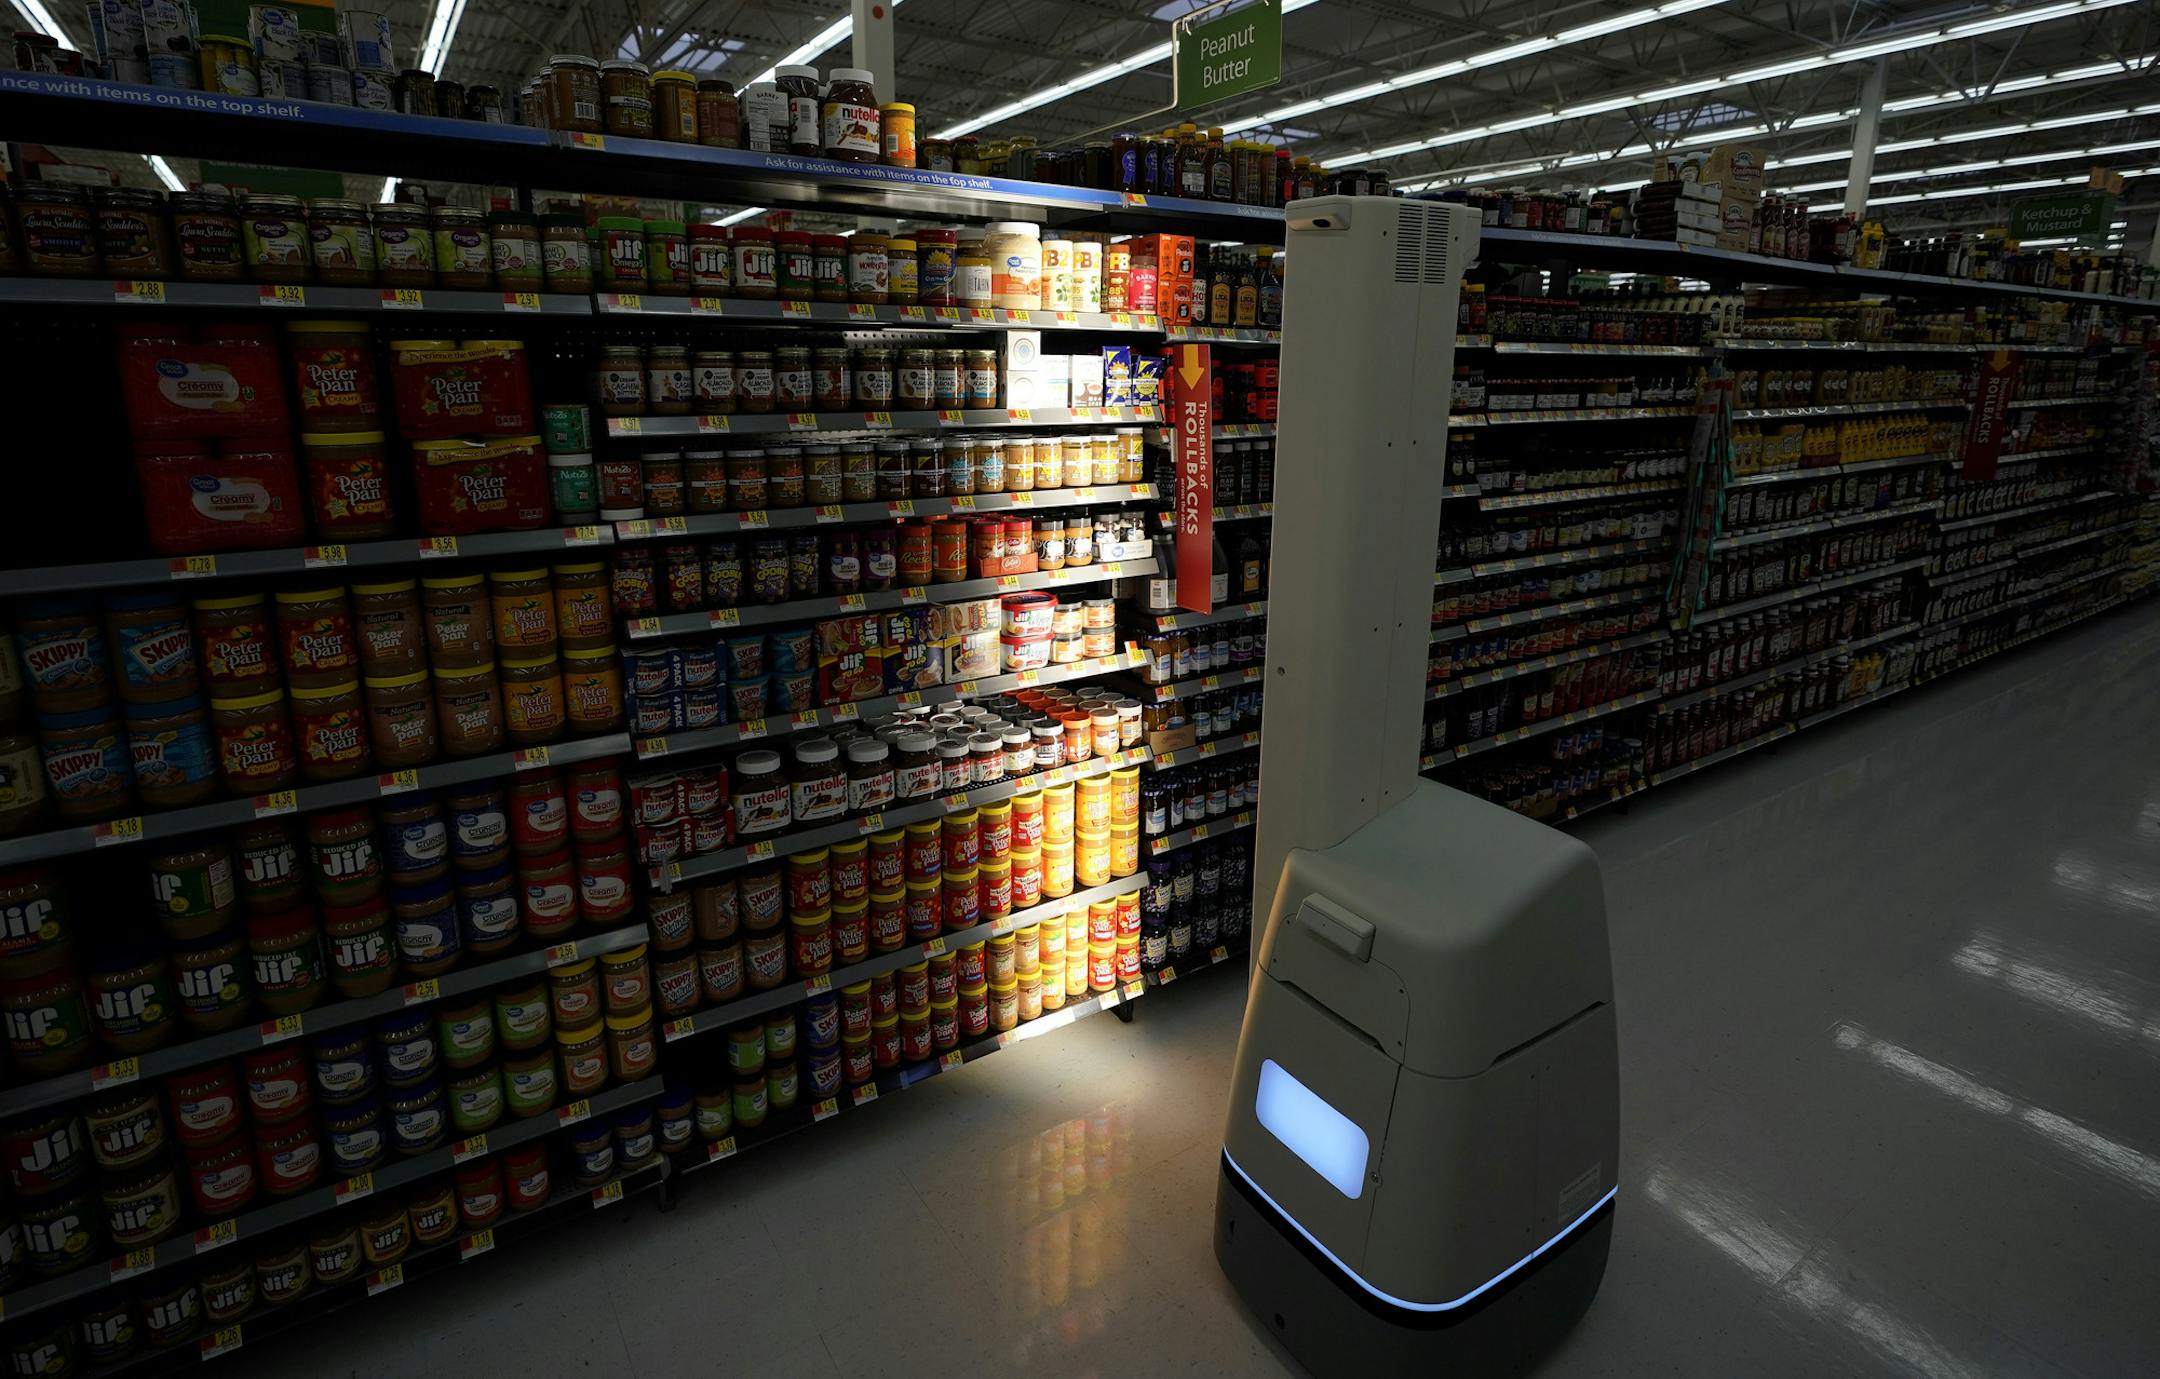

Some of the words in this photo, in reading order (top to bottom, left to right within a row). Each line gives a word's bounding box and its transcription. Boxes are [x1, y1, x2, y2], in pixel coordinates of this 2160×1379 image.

[1201, 23, 1255, 60] Peanut
[1203, 57, 1251, 89] Butter
[45, 77, 91, 97] with
[97, 83, 151, 103] items
[157, 91, 180, 106] on
[186, 91, 217, 109] the
[222, 97, 252, 116] top
[258, 101, 304, 119] shelf.
[842, 106, 881, 124] nutella
[765, 157, 786, 168] Ask
[788, 160, 804, 171] for
[807, 163, 861, 176] assistance
[863, 168, 886, 178] with
[887, 170, 915, 181] items
[917, 174, 930, 183] on
[932, 174, 948, 184] the
[950, 176, 966, 188] top
[968, 178, 993, 189] shelf.
[2022, 204, 2078, 222] Ketchup
[2081, 203, 2092, 216] &
[2026, 218, 2082, 233] Mustard
[610, 239, 643, 261] Jif
[694, 250, 729, 273] Jif
[745, 253, 776, 274] Jif
[815, 261, 842, 279] Jif
[139, 282, 160, 297] 2.88
[281, 286, 300, 300] 3.92
[400, 289, 418, 303] 3.92
[306, 364, 359, 383] Peter
[177, 380, 224, 392] Creamy
[431, 377, 482, 394] Peter
[1977, 377, 2000, 444] ROLLBACKS
[1200, 400, 1208, 471] Thousands
[1185, 401, 1198, 535] ROLLBACKS
[335, 476, 383, 492] Peter
[459, 475, 507, 492] Peter
[1201, 473, 1208, 490] of
[210, 494, 255, 505] Creamy
[323, 546, 341, 559] 5.98
[191, 557, 211, 571] 7.78
[613, 579, 648, 592] GOOBER
[512, 609, 547, 622] Peter
[571, 602, 604, 614] Peter
[435, 623, 469, 636] Peter
[642, 618, 657, 629] 2.64
[302, 635, 344, 650] Peter
[367, 631, 403, 641] Peter
[140, 632, 191, 664] SKIPPY
[216, 639, 263, 658] Peter
[904, 645, 926, 660] Jif
[28, 641, 85, 673] SKIPPY
[840, 653, 864, 670] Jif
[236, 665, 266, 675] CREAMY
[636, 669, 669, 683] nutella
[673, 662, 682, 688] PACK
[687, 662, 718, 676] nutella
[519, 694, 553, 708] Peter
[576, 687, 609, 699] Peter
[456, 709, 490, 724] Peter
[673, 703, 682, 728] PACK
[690, 702, 720, 716] nutella
[390, 718, 425, 734] Peter
[320, 727, 360, 744] Peter
[230, 741, 276, 757] Peter
[528, 747, 544, 759] 4.36
[48, 751, 100, 781] SKIPPY
[907, 764, 941, 781] nutella
[397, 772, 413, 784] 4.36
[803, 774, 847, 795] nutella
[859, 773, 892, 791] nutella
[274, 792, 292, 806] 4.36
[743, 786, 789, 808] nutella
[587, 800, 618, 812] Creamy
[117, 819, 137, 836] 5.18
[244, 848, 296, 882] Jif
[323, 844, 373, 877] Jif
[537, 893, 567, 907] Creamy
[588, 886, 618, 897] Creamy
[750, 887, 780, 906] SKIPPY
[656, 906, 688, 926] SKIPPY
[335, 936, 384, 968] Jif
[754, 948, 784, 967] SKIPPY
[254, 956, 303, 984] Jif
[705, 961, 735, 979] SKIPPY
[178, 963, 235, 998] Jif
[661, 972, 691, 994] SKIPPY
[96, 983, 156, 1020] Jif
[280, 1017, 298, 1030] 5.33
[114, 1059, 134, 1076] 5.33
[257, 1087, 289, 1100] Creamy
[192, 1105, 224, 1120] Creamy
[103, 1118, 152, 1152] Jif
[212, 1172, 245, 1191] Creamy
[110, 1203, 157, 1232] Jif
[418, 1210, 444, 1228] Jif
[214, 1222, 232, 1236] 2.00
[375, 1227, 401, 1250] Jif
[316, 1253, 347, 1272] Jif
[264, 1271, 296, 1291] Jif
[212, 1283, 248, 1309] Jif
[147, 1287, 198, 1330] Jif
